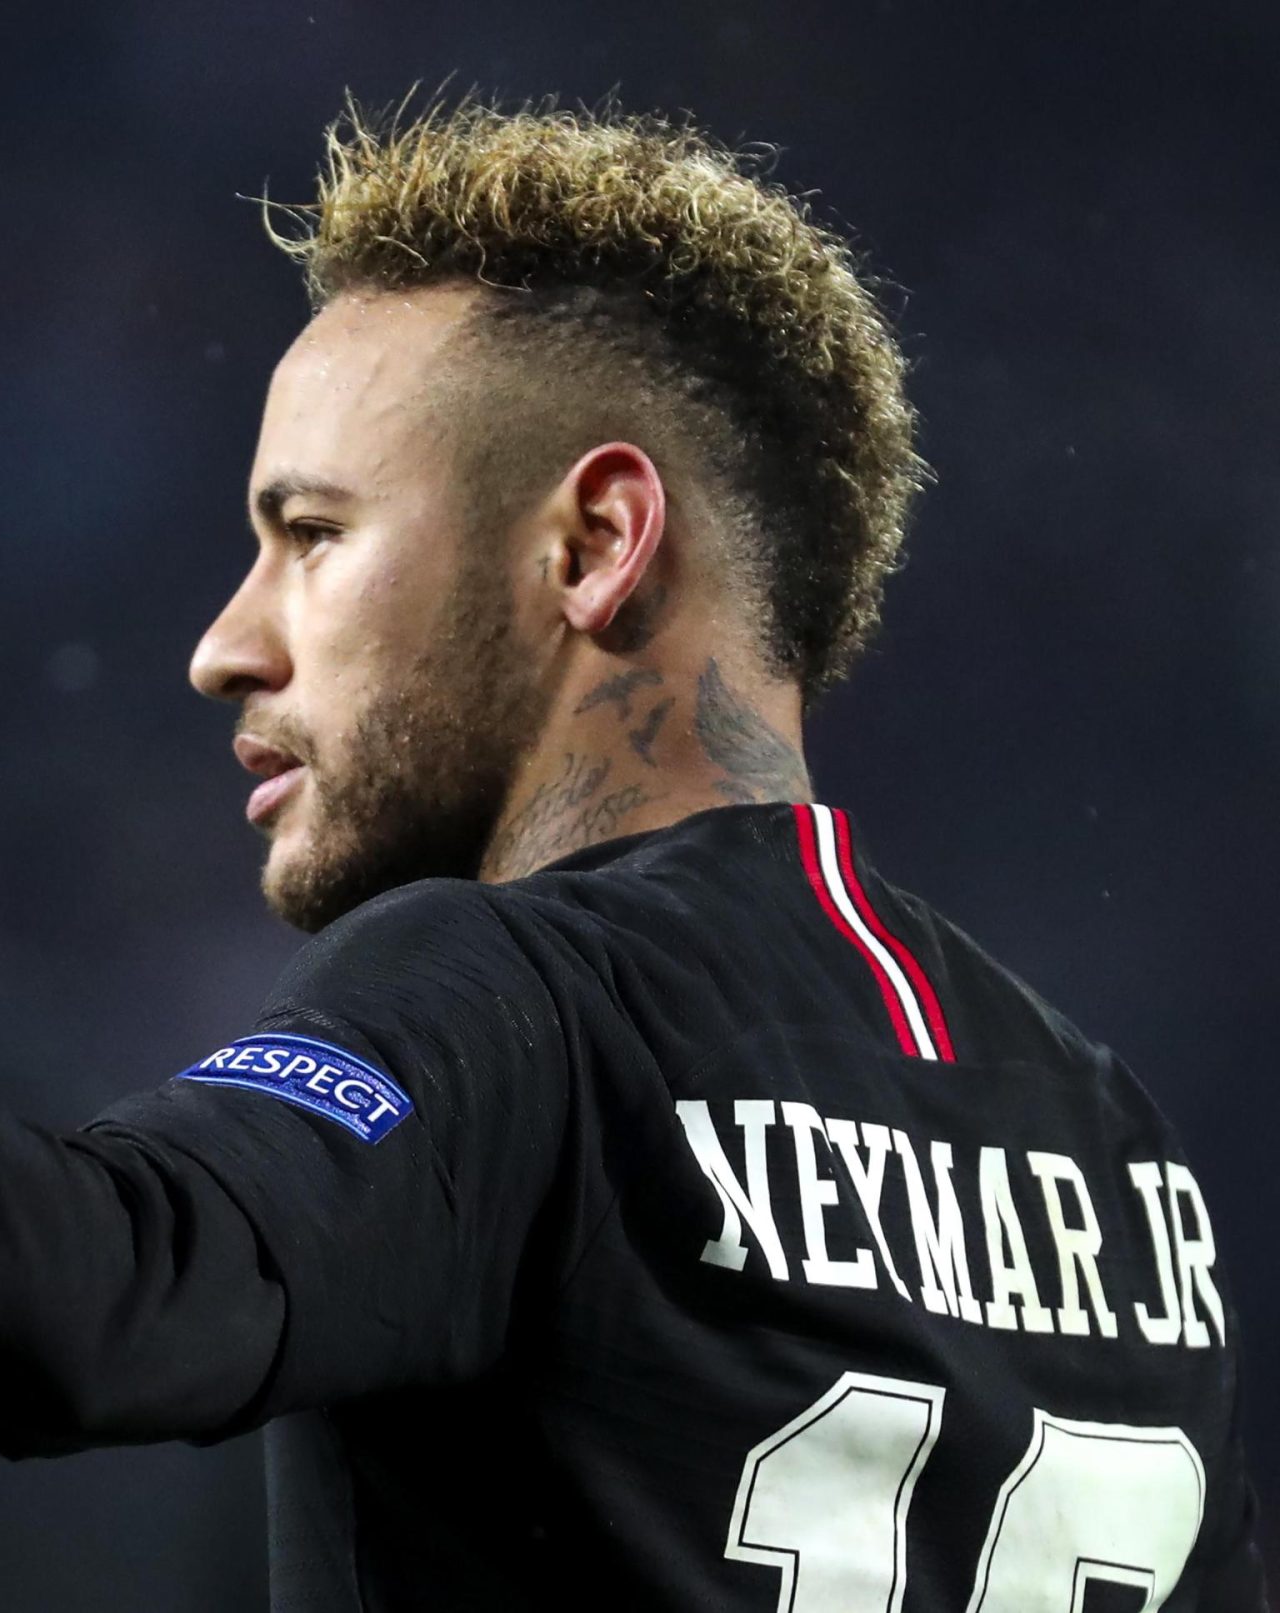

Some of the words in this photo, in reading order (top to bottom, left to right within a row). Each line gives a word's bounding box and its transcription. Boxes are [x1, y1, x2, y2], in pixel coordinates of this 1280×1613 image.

[200, 1047, 399, 1122] RESPECT
[676, 1100, 1118, 1338] NEYMAR
[1128, 1161, 1225, 1348] JR
